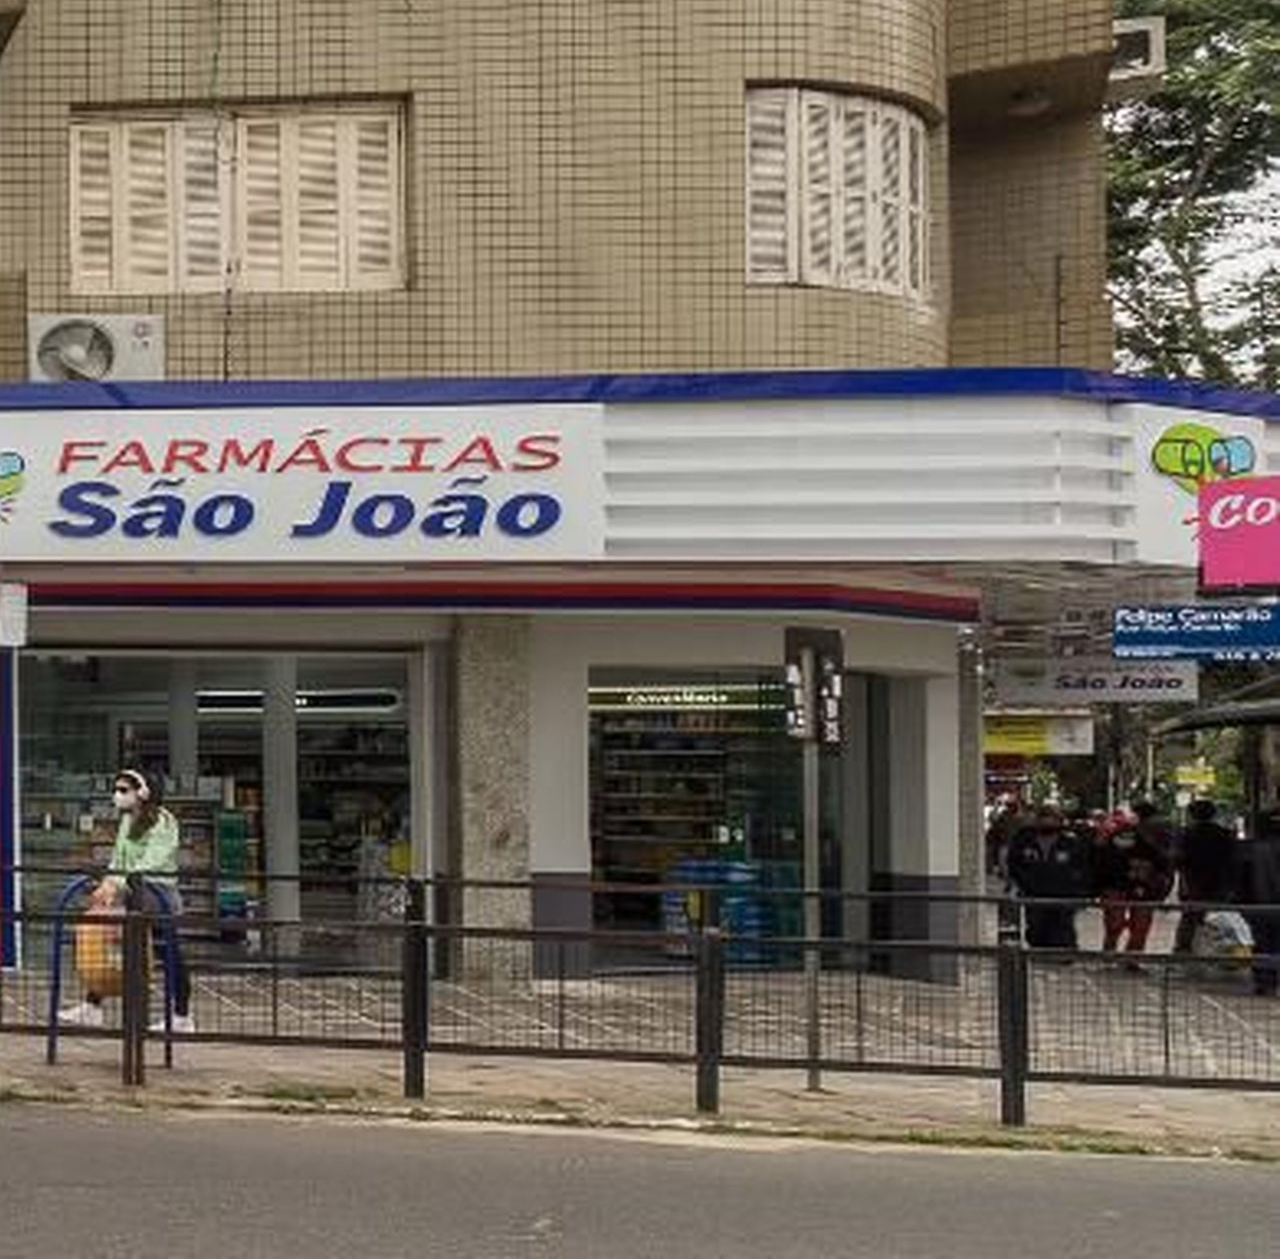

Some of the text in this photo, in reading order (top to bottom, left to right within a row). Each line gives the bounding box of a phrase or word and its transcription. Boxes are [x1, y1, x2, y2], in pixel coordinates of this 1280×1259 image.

[55, 429, 562, 474] FARMÁCIAS
[47, 474, 562, 539] São João
